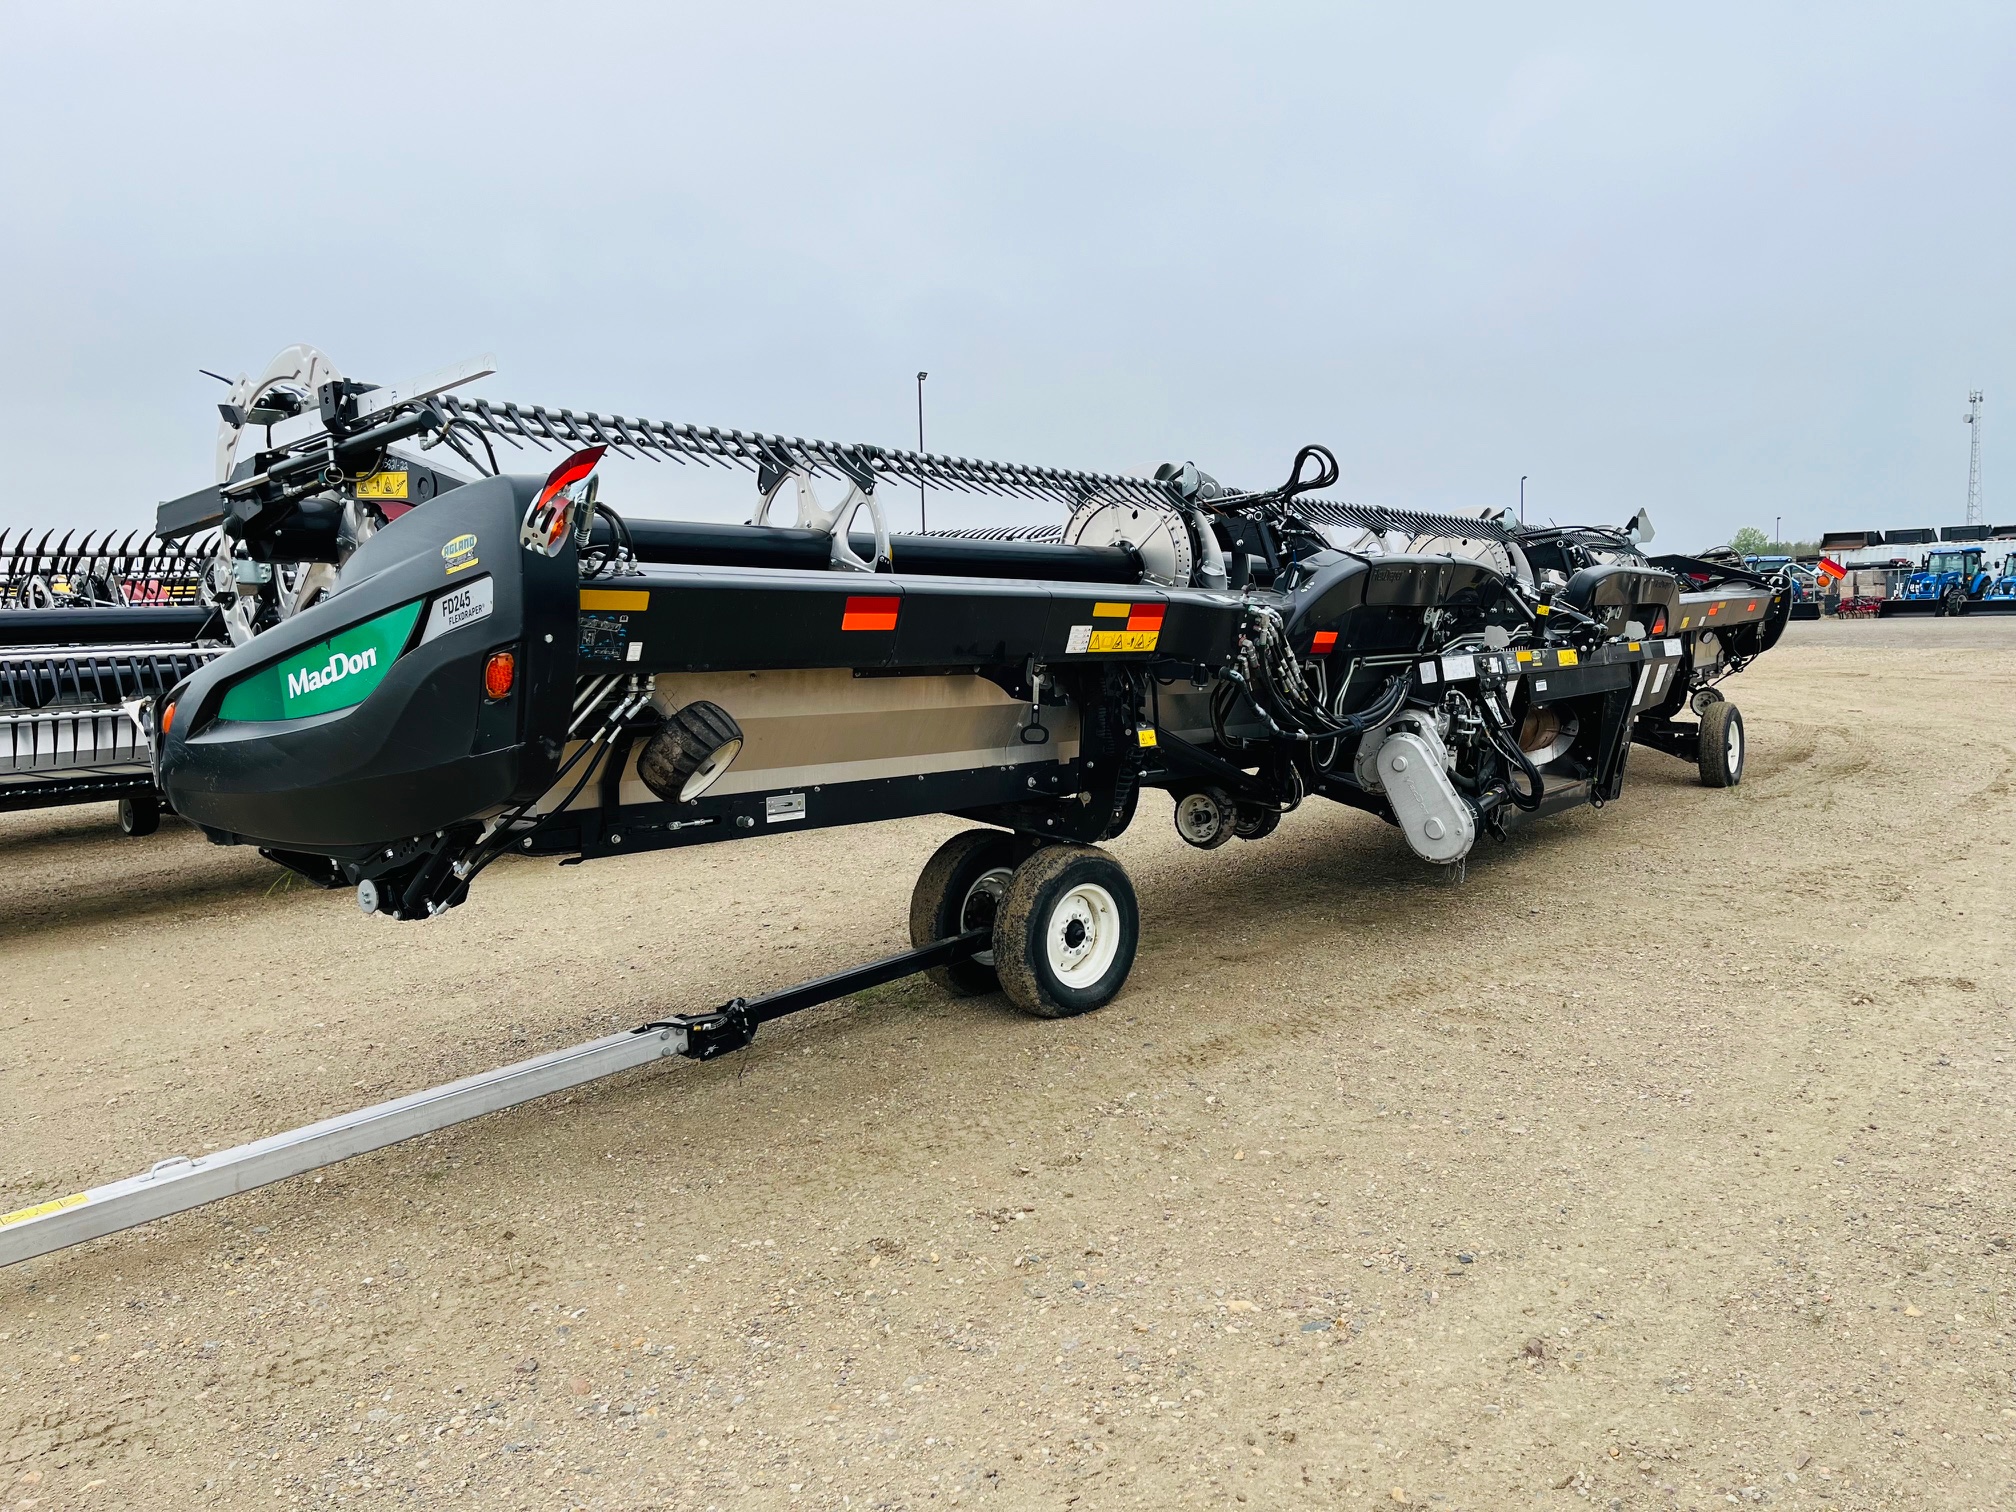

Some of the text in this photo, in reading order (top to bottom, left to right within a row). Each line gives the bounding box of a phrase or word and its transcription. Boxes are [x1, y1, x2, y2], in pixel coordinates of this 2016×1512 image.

[444, 536, 475, 556] AGLAND
[442, 590, 471, 617] FD245
[288, 647, 377, 699] MacDon
